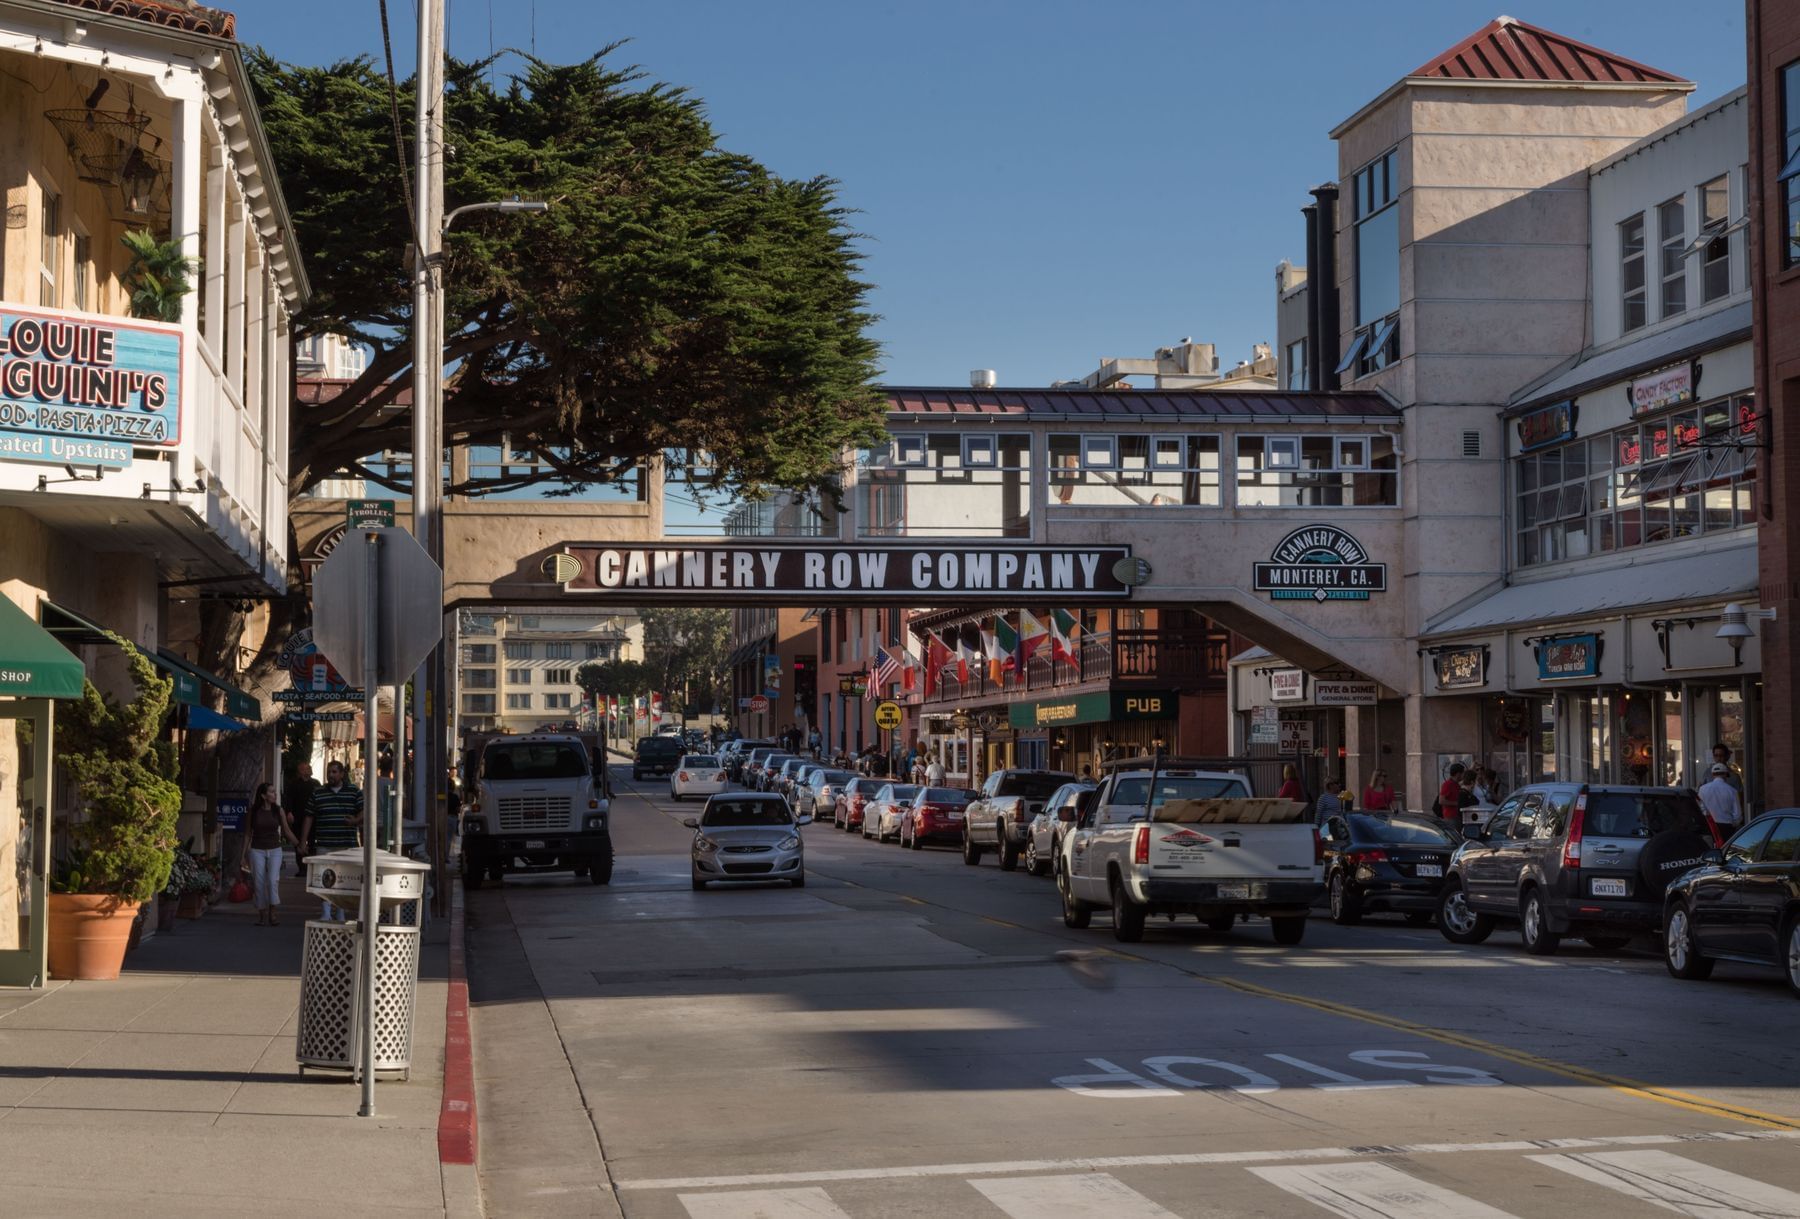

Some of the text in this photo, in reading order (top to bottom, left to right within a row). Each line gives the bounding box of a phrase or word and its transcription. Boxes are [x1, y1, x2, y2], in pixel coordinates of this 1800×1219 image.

[0, 359, 167, 411] GUINI'S
[1636, 376, 1686, 401] CANDY FACTORY
[38, 408, 98, 431] PASTA
[103, 413, 165, 439] PIZZA
[0, 438, 128, 461] ated Upstairs
[1281, 530, 1361, 562] CANNERY ROW
[599, 550, 1101, 590] CANNERY ROW COMPANY
[1270, 569, 1372, 586] MONTEREY, CA.
[1, 671, 32, 682] SHOP
[274, 692, 365, 700] PASTA SEAFOOD PIZZ
[1318, 686, 1340, 694] FIVE
[1350, 686, 1375, 694] DIME
[1126, 698, 1162, 712] PUB
[1282, 722, 1307, 730] FIVE
[1291, 731, 1300, 739] &
[1281, 740, 1310, 748] DIME
[1659, 857, 1704, 870] HONDA
[1050, 1049, 1504, 1099] STOP
